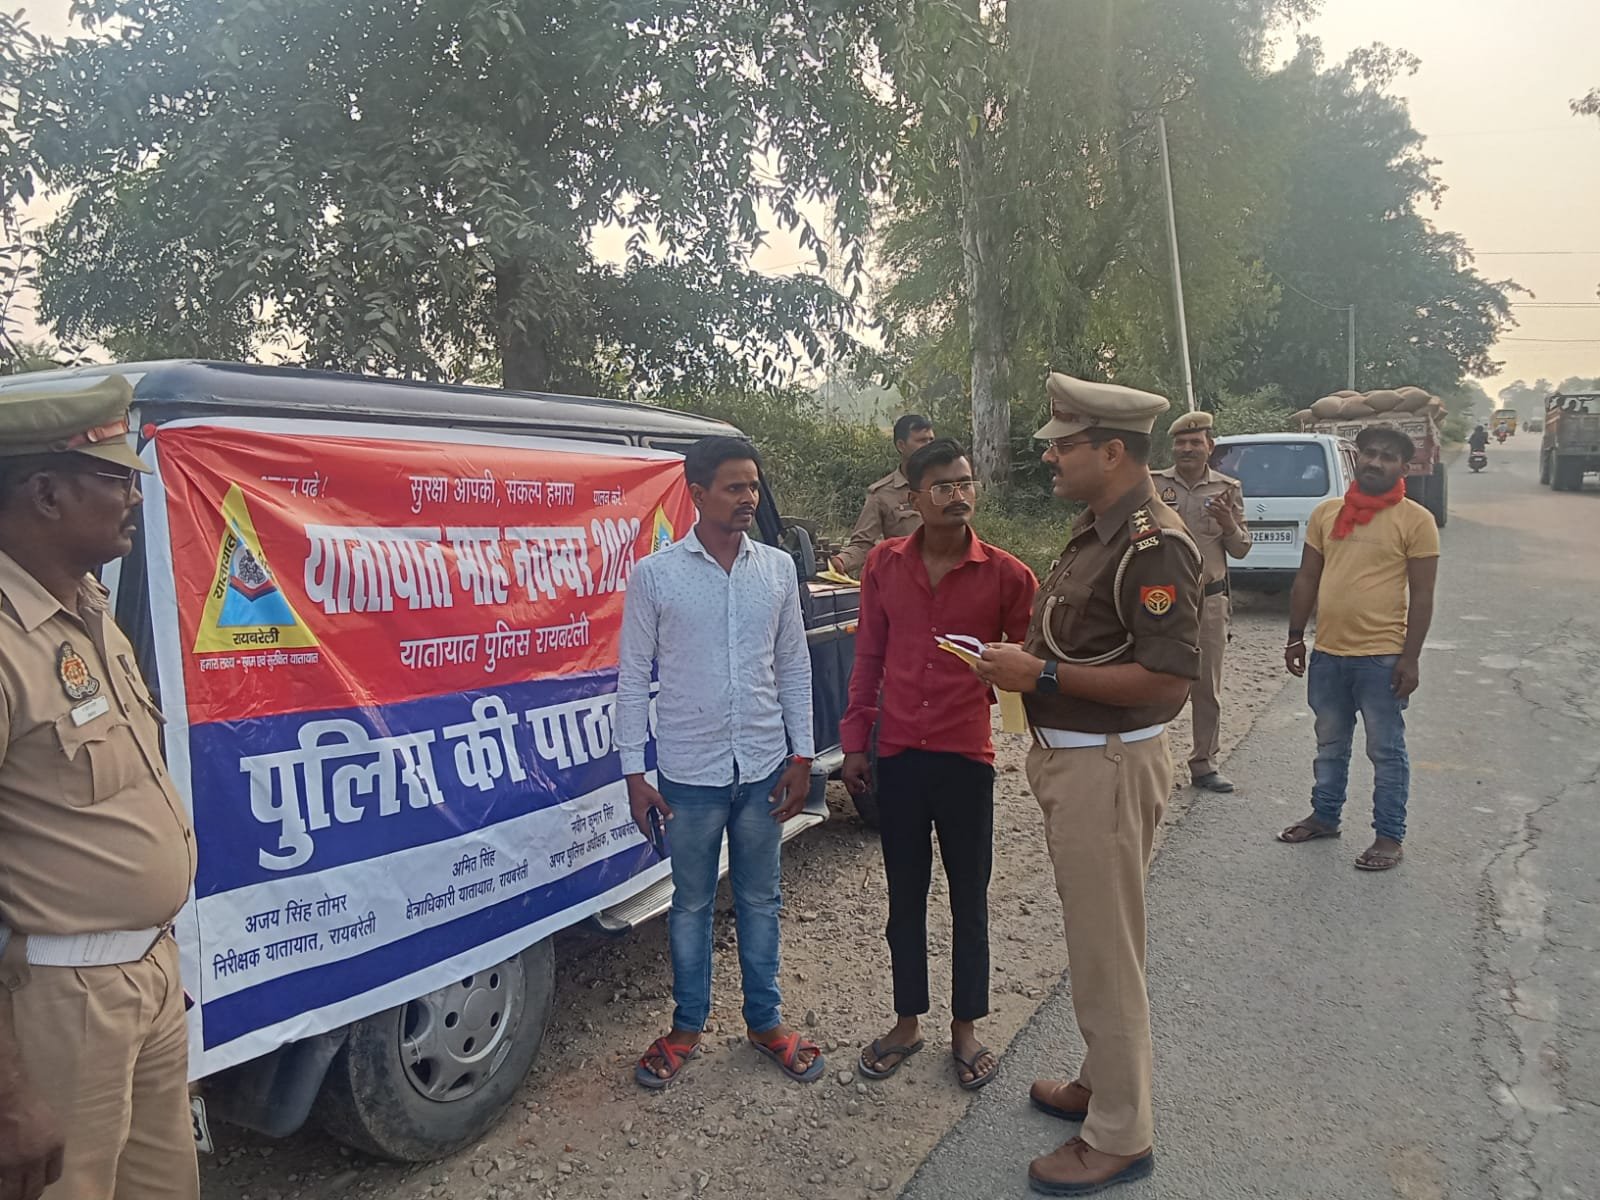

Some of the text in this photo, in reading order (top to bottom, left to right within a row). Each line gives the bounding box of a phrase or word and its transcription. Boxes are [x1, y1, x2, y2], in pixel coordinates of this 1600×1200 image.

[409, 468, 575, 514] सुरक्षा आपकी, संकल्प हमारा
[213, 533, 237, 600] यातायात
[304, 524, 453, 614] यातायात
[446, 526, 508, 605] माह
[505, 526, 593, 602] नवम्बर
[591, 516, 640, 595] 2023
[232, 627, 280, 645] रायबरेली
[289, 652, 318, 665] यातायात
[400, 611, 590, 673] यातायात पुलिस रायबरेली
[239, 718, 445, 871] पुलिस
[443, 695, 527, 792] की
[452, 847, 496, 877] अमित सिंह
[549, 851, 566, 868] अपर
[567, 841, 585, 868] पुलिस
[245, 893, 347, 934] अजय सिंह तोमर
[406, 859, 529, 920] क्षेत्राधिकारी यातायात, रायबरेली
[213, 911, 376, 980] निरीक्षक यातायात, रायबरेली
